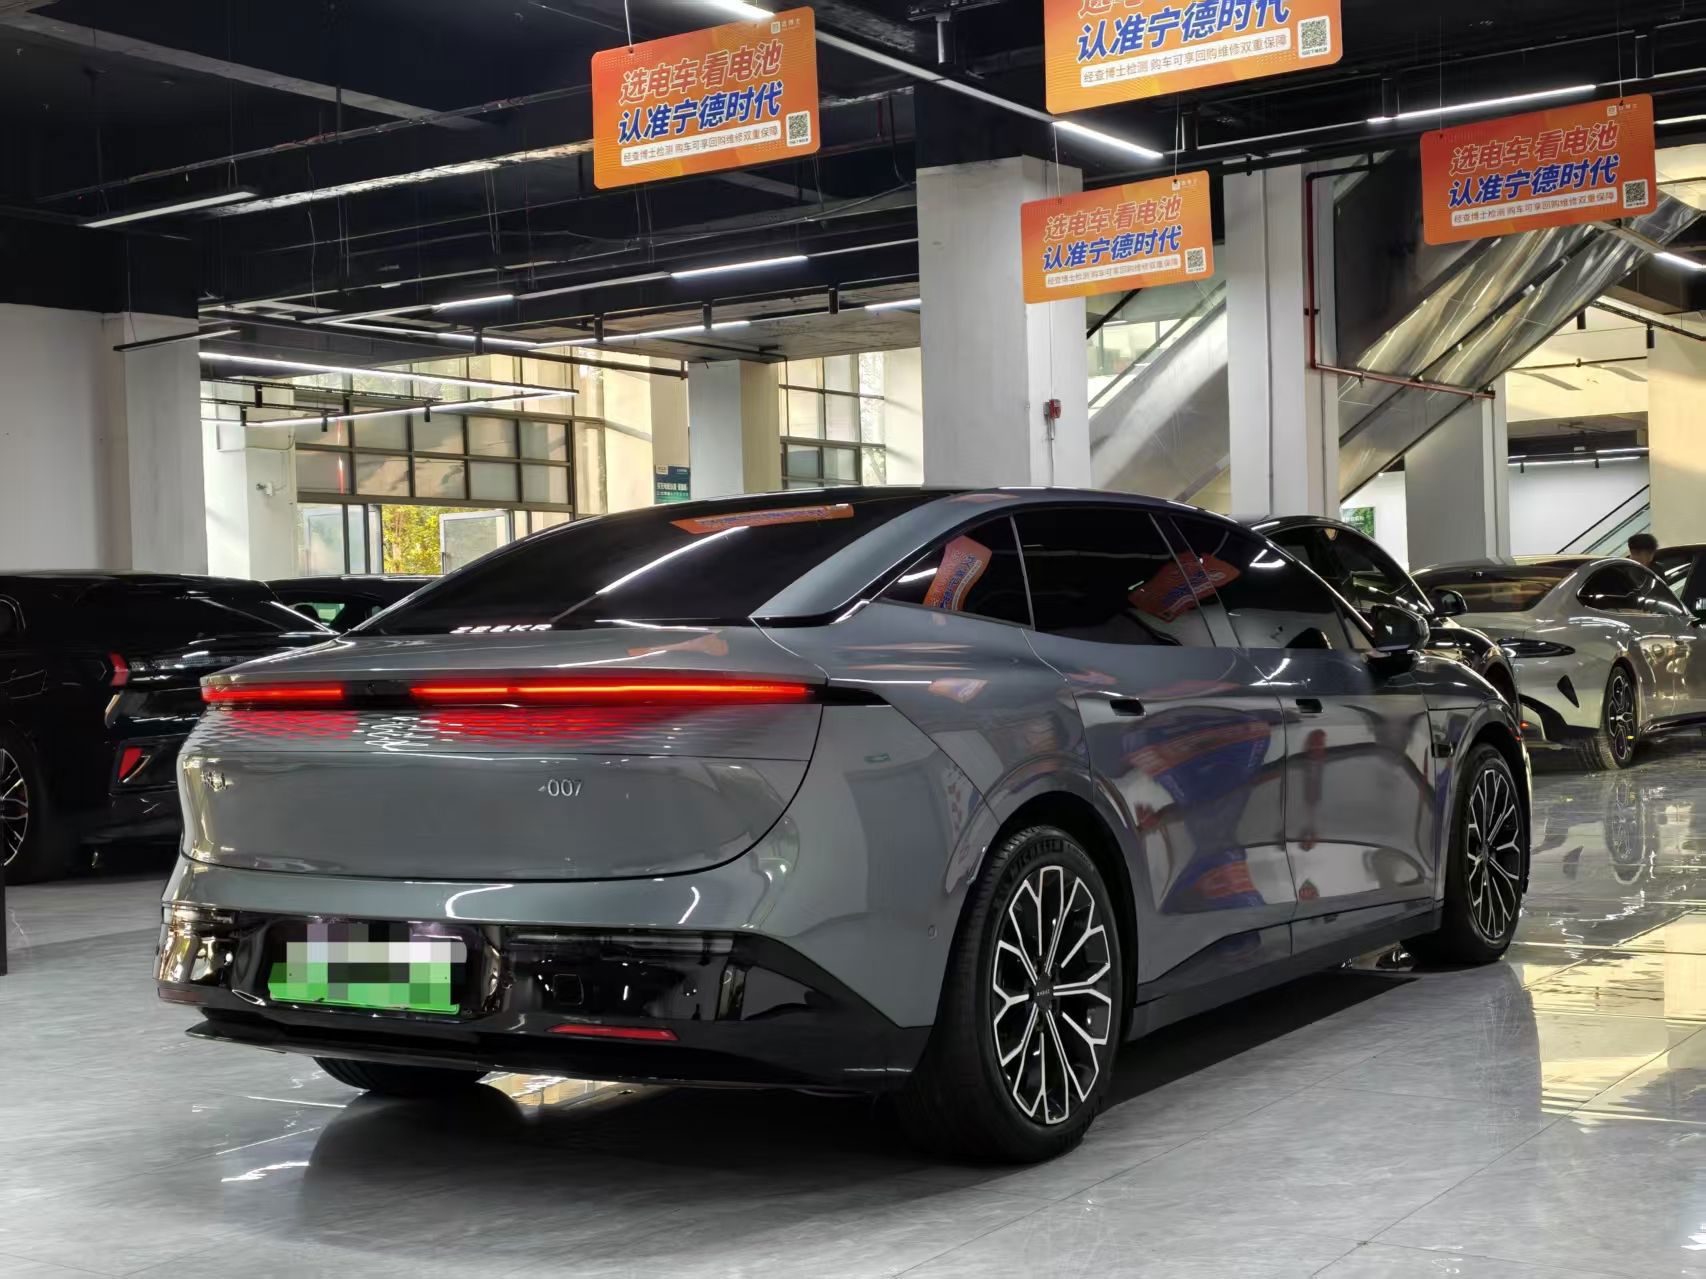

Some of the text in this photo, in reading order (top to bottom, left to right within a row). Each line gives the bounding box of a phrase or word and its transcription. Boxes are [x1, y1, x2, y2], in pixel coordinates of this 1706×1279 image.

[617, 80, 784, 145] 认准宁德时代
[1448, 154, 1621, 208] 认准宁德时代
[1042, 224, 1183, 272] 认准宁德时代
[547, 779, 582, 797] 007
